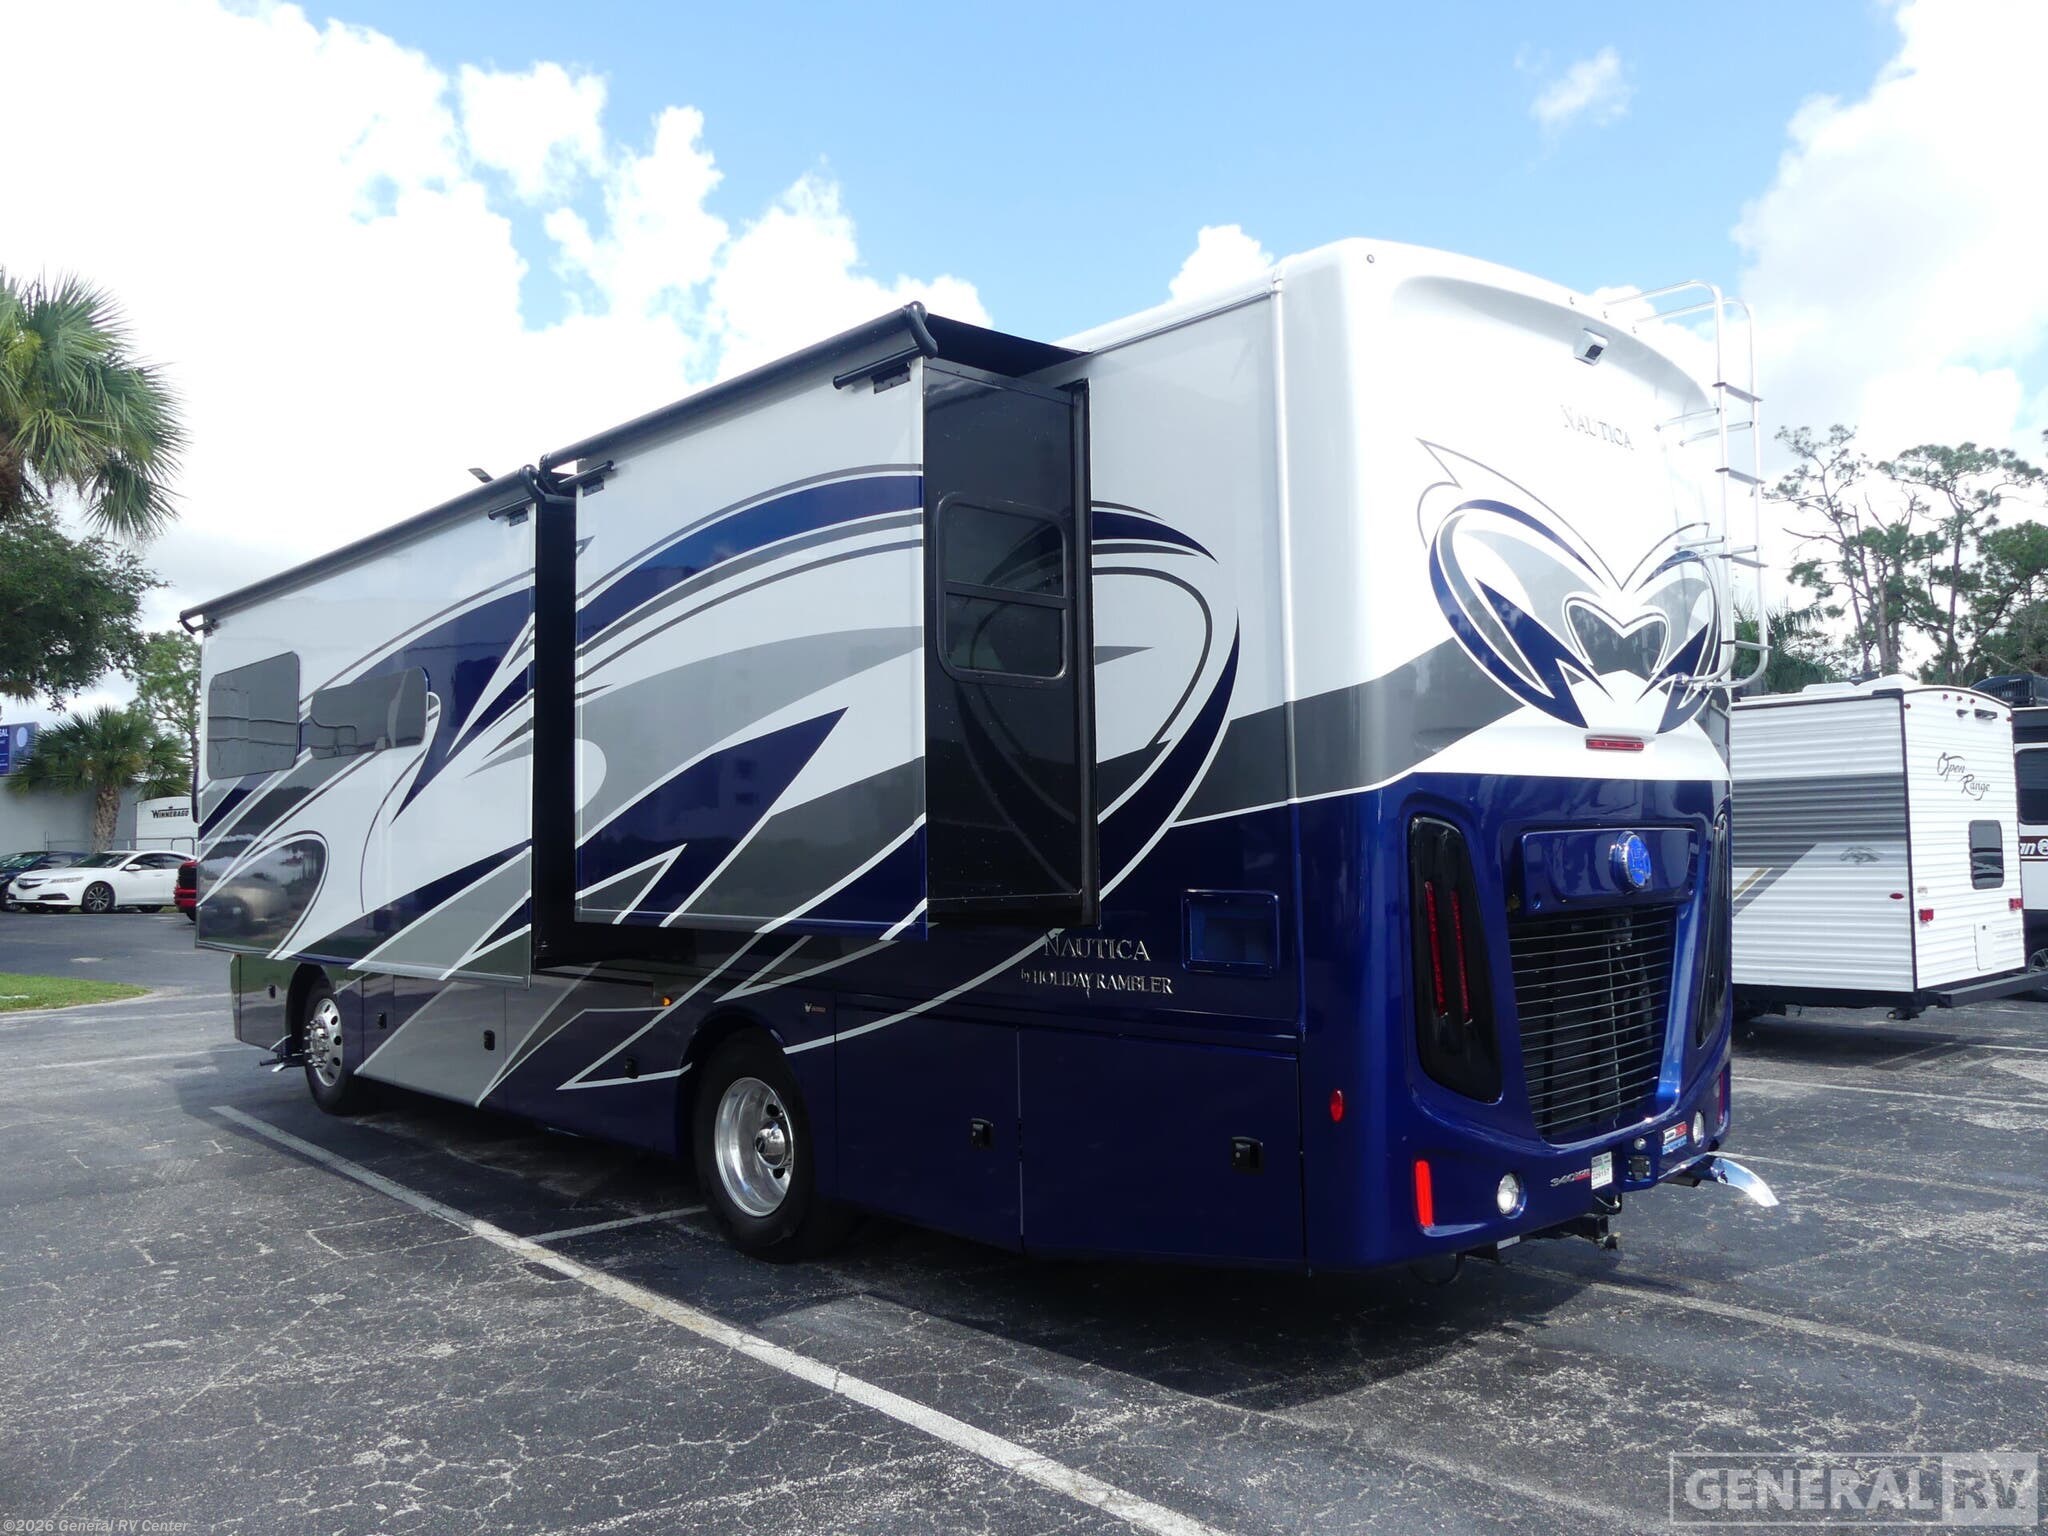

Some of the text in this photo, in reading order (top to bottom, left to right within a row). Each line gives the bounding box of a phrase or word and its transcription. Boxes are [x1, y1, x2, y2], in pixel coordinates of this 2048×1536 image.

[1937, 752, 1966, 782] Open
[1959, 774, 1990, 801] Range
[1044, 932, 1151, 961] NAUTICA
[1021, 968, 1173, 998] by HOLIDAY RAMBLER
